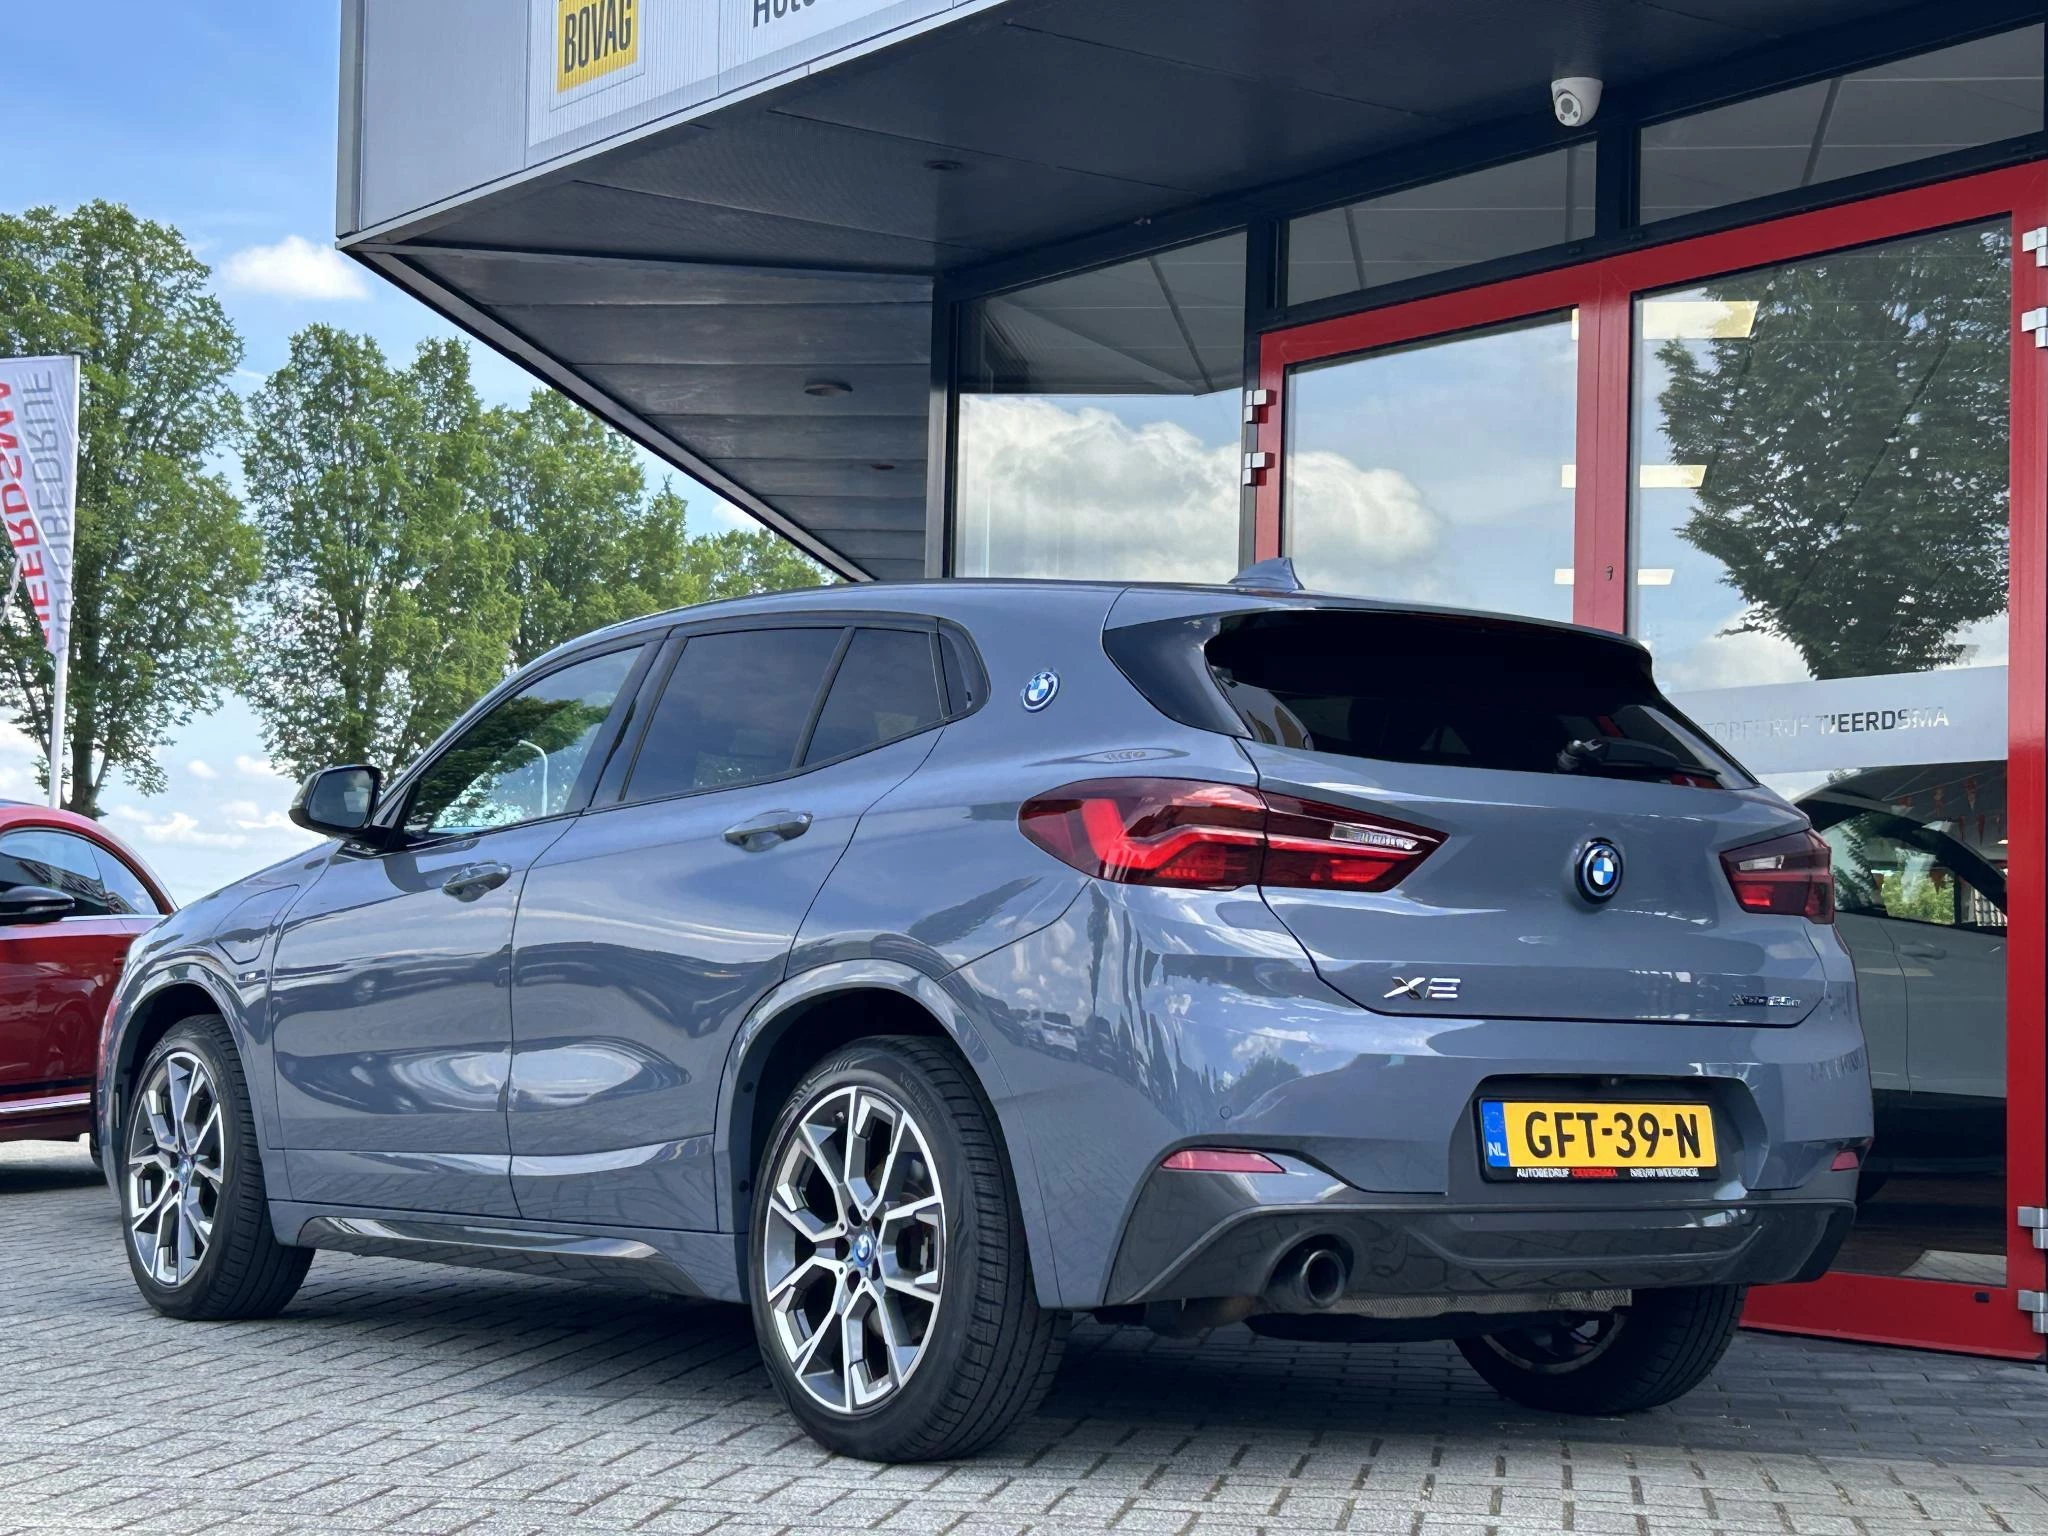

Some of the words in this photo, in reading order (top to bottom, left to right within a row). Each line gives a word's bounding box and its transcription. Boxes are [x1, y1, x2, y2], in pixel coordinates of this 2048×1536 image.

[564, 0, 632, 73] BOVAG
[1815, 706, 1949, 736] TJEERDSMA
[1488, 1142, 1507, 1157] NL
[1525, 1111, 1700, 1158] GFT-39-N
